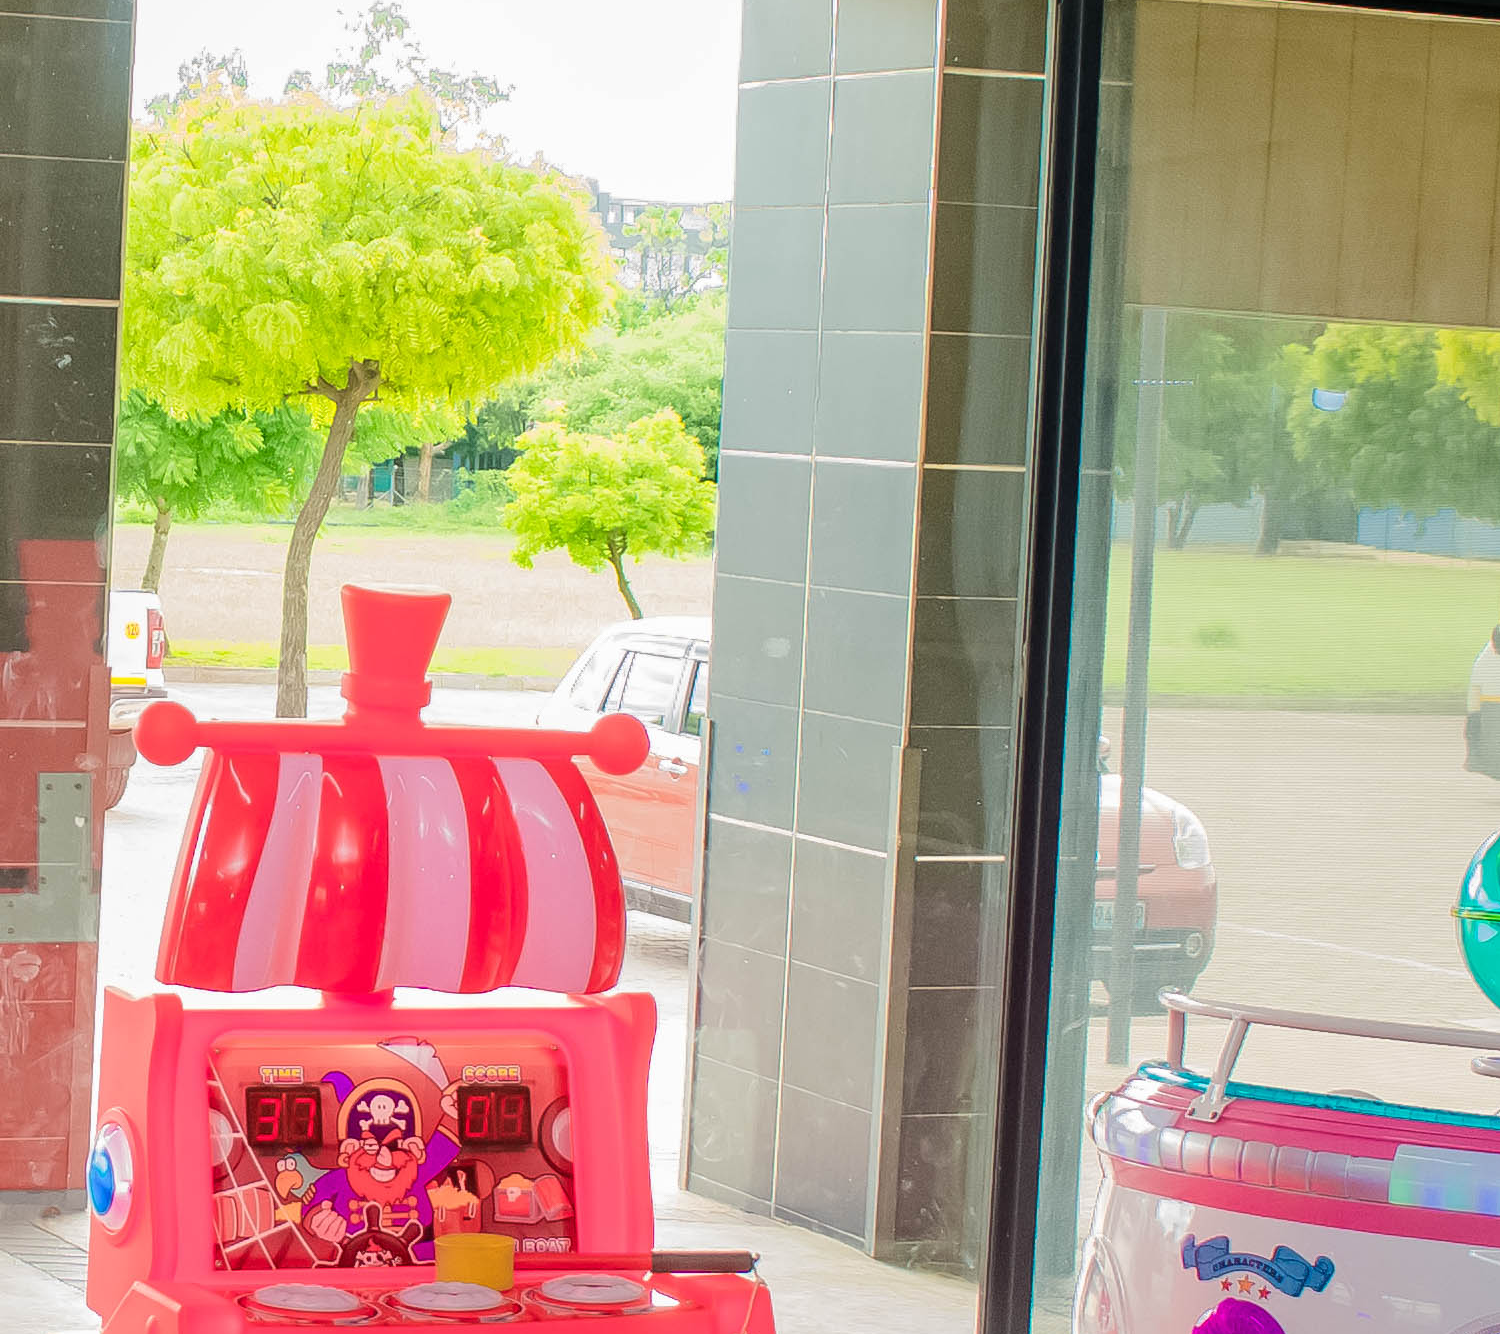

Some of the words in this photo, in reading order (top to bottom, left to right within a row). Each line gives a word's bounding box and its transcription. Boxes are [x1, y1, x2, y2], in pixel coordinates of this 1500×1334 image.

[261, 1066, 303, 1084] TIME
[463, 1065, 521, 1084] SCORE
[255, 1097, 318, 1142] 37
[523, 1238, 573, 1255] BOAT
